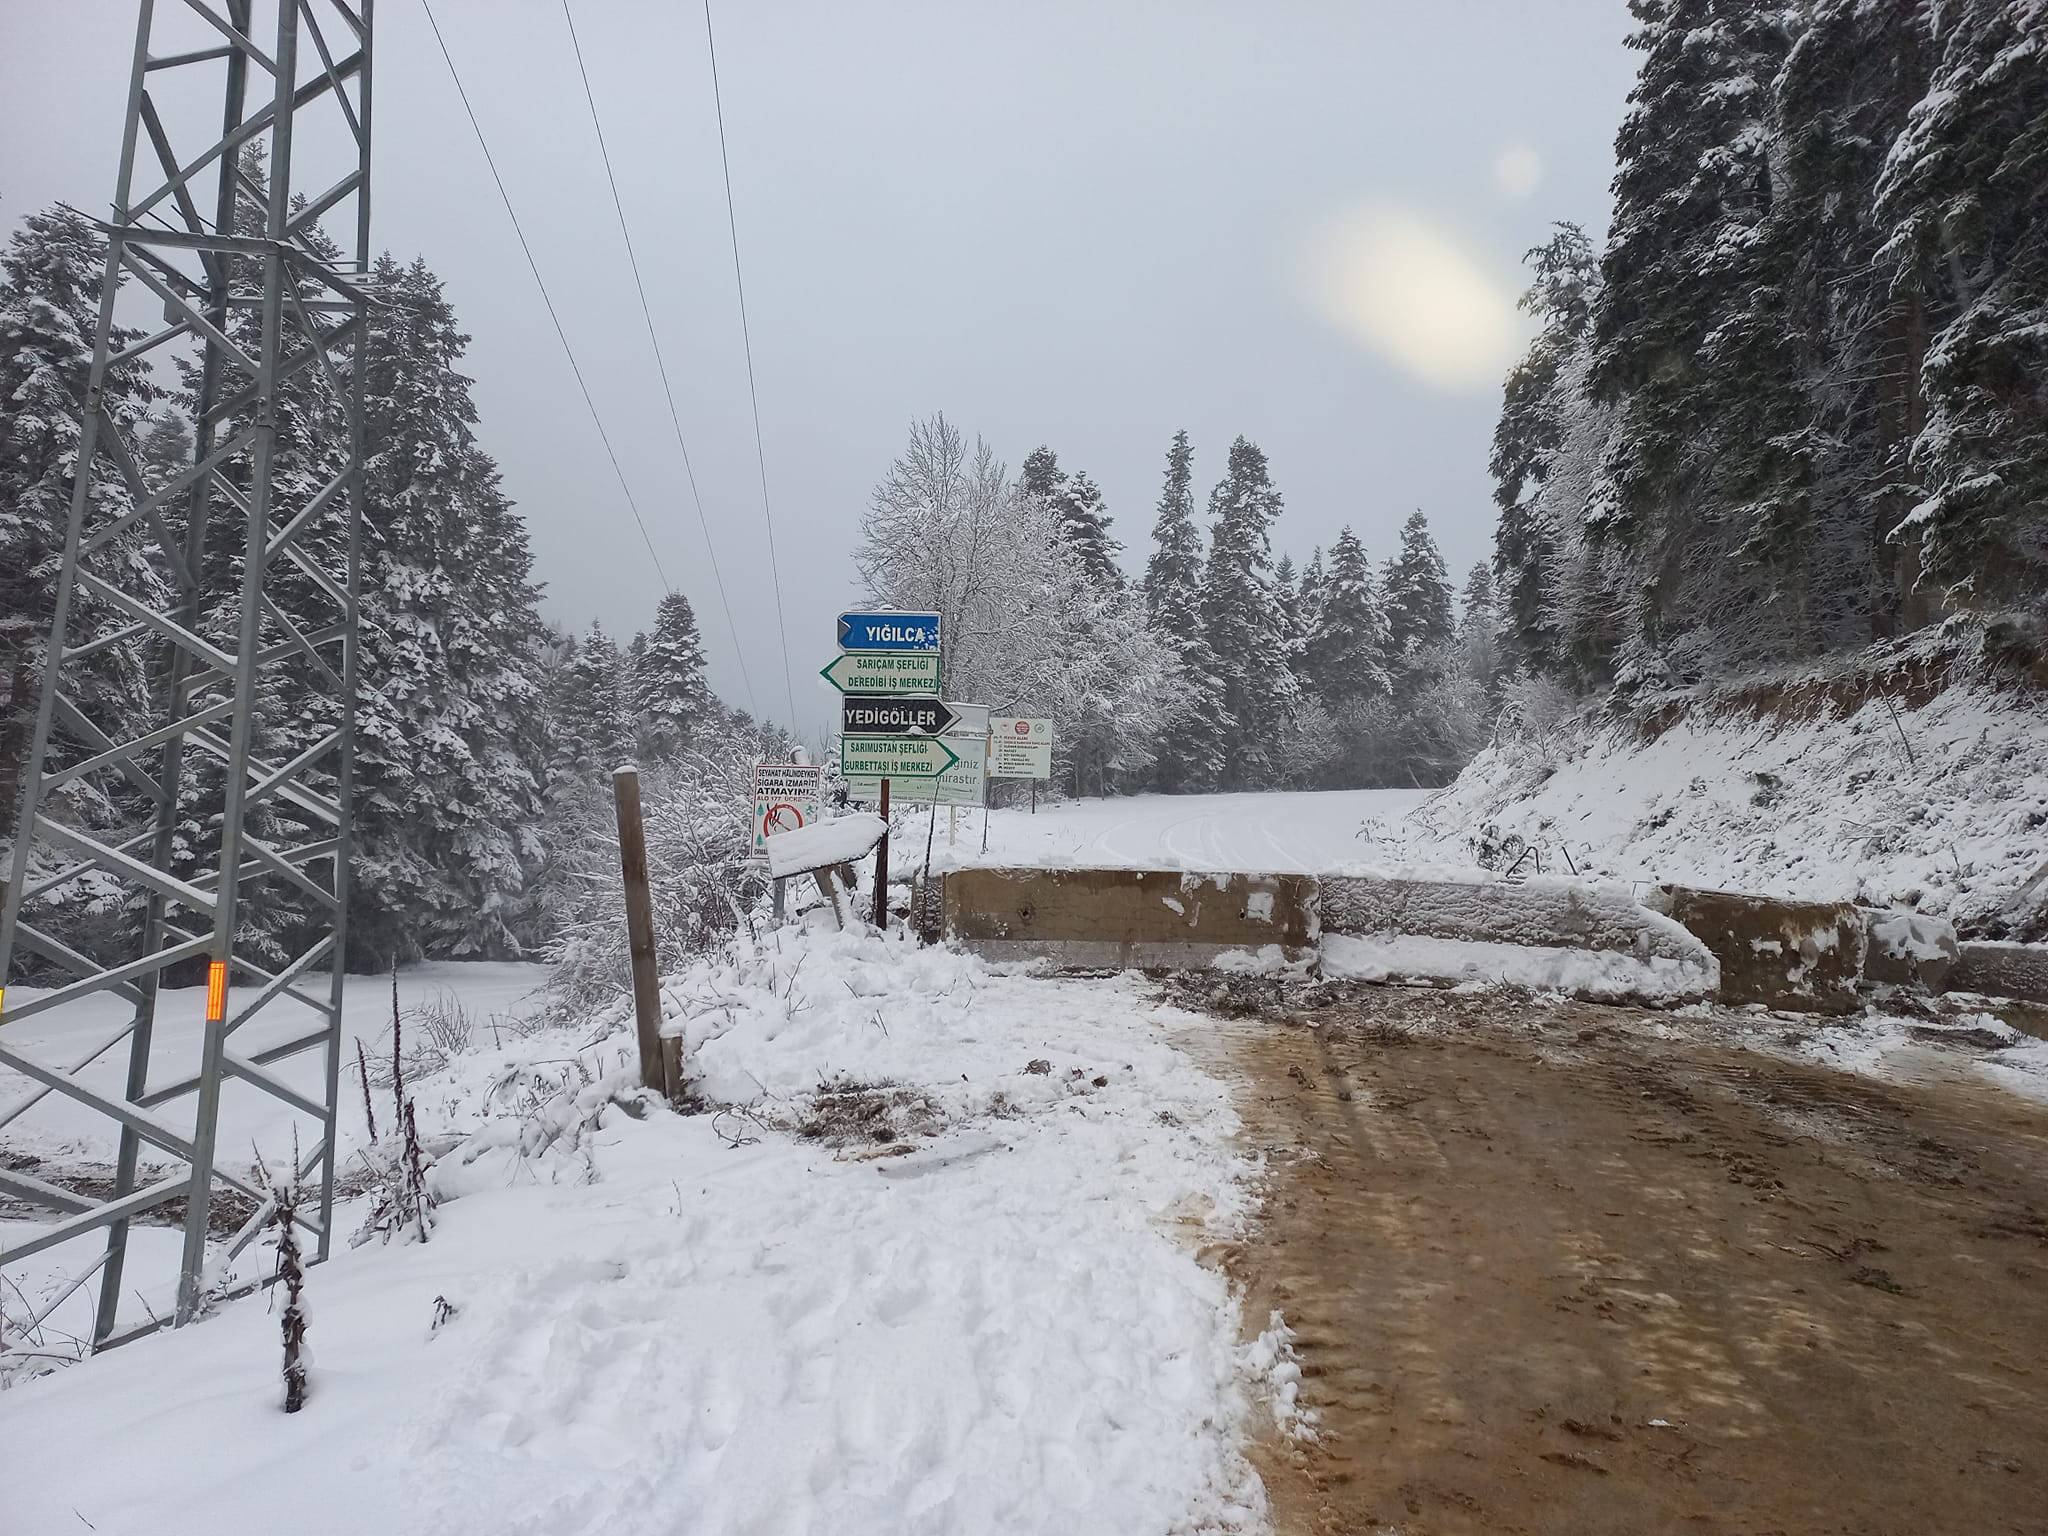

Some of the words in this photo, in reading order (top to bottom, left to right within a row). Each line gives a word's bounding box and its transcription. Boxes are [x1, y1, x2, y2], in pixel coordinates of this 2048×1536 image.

[866, 624, 925, 642] YIĞILCA
[857, 659, 895, 672] SARIÇAM
[897, 658, 929, 672] ŞEFLİĞİ
[848, 676, 887, 688] DEREDİBİ
[889, 676, 897, 690] İŞ
[899, 676, 937, 689] MERKEZİ
[846, 707, 936, 726] YEDİGÖLLER
[851, 742, 898, 754] SARIMUSTAN
[899, 742, 928, 756] ŞEFLİĞİ
[758, 769, 782, 777] SEYAHAT
[845, 761, 890, 774] GURBETTAŞI
[891, 760, 898, 774] İŞ
[900, 760, 933, 772] MERKEZİ
[757, 778, 784, 787] SİGARA
[785, 778, 817, 788] İZMARİTİ
